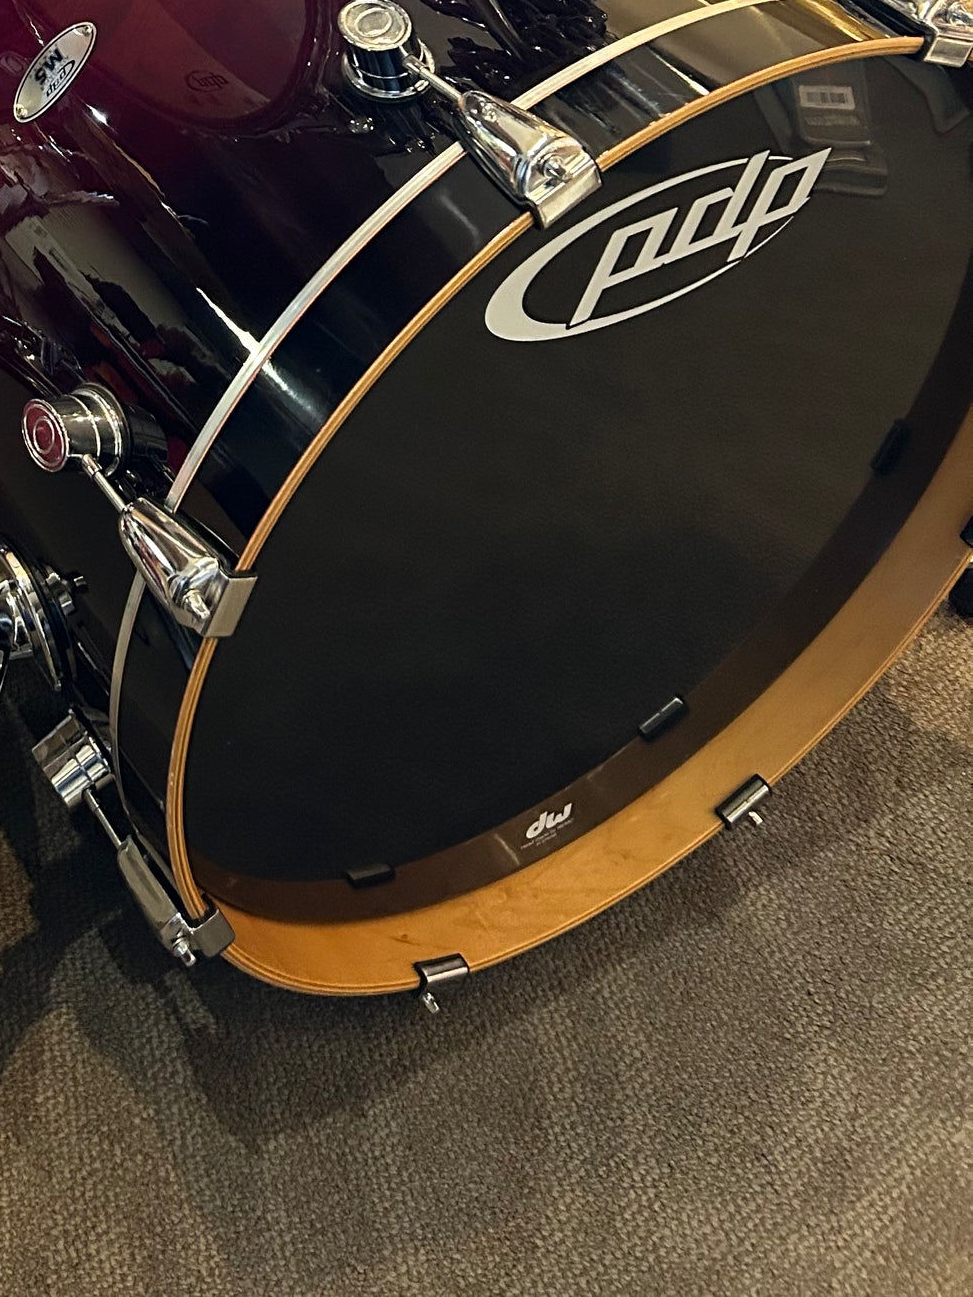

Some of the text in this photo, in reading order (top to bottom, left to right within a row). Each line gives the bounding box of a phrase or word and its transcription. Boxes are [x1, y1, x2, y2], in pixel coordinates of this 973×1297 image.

[34, 48, 64, 86] M5
[565, 146, 832, 328] pdp
[526, 802, 573, 839] dw
